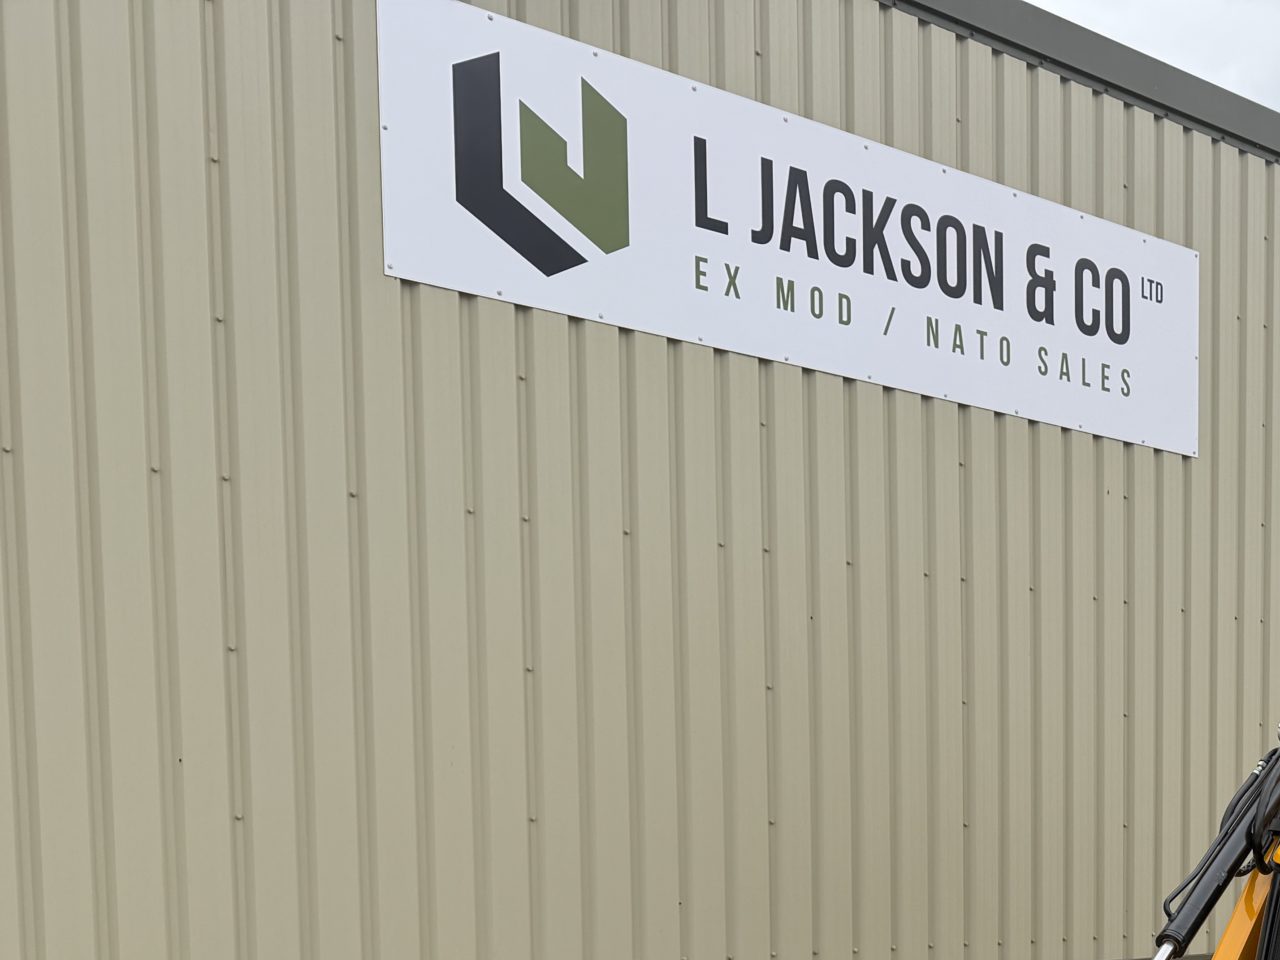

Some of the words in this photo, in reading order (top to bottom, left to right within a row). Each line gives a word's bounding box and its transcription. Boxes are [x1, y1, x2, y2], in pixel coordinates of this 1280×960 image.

[694, 135, 729, 236] L
[751, 156, 1005, 312] JACKSON
[1026, 243, 1057, 327] &
[1074, 257, 1131, 346] CO
[1140, 276, 1164, 305] LTD
[694, 255, 741, 300] EX
[775, 276, 852, 326] MOD
[883, 306, 896, 336] /
[926, 315, 1011, 367] NATO
[1037, 346, 1131, 398] SALES
